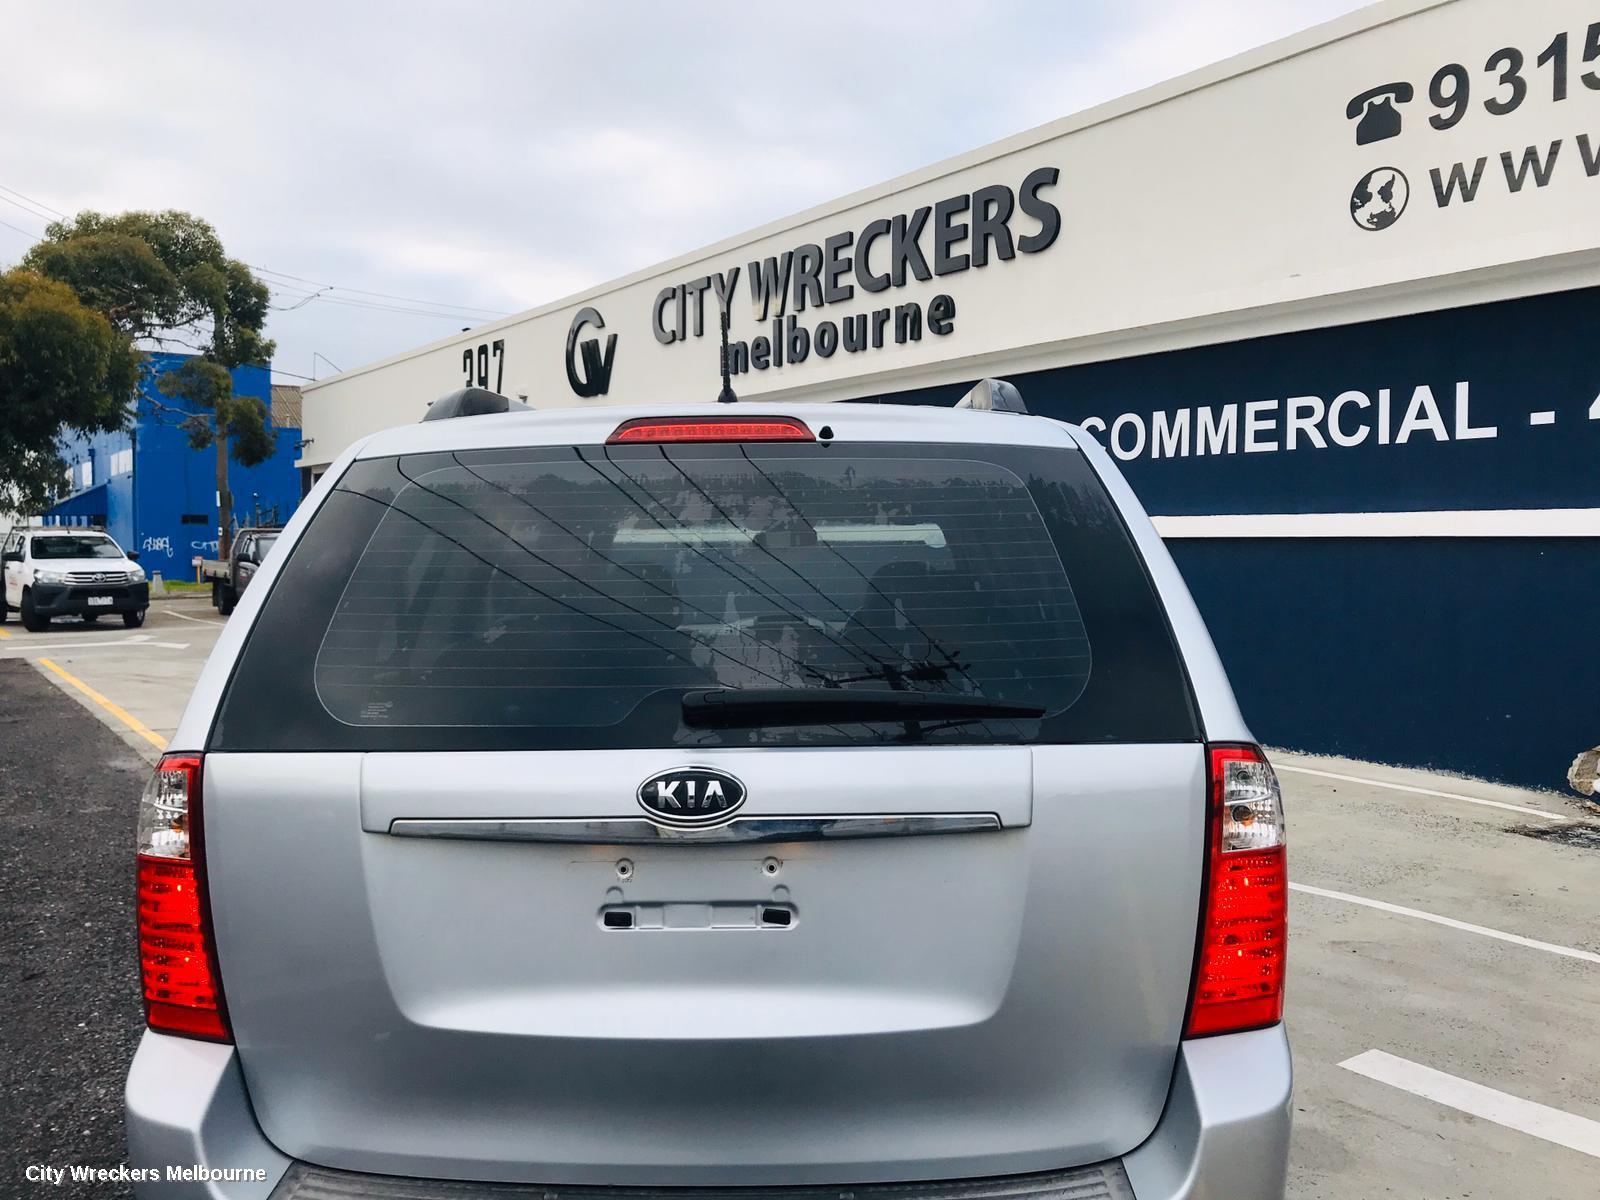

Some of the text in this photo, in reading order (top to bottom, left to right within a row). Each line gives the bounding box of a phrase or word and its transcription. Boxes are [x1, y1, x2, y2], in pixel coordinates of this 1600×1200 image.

[653, 167, 1061, 344] CITY WRECKERS
[720, 294, 956, 377] melbourne
[656, 780, 728, 808] KIA
